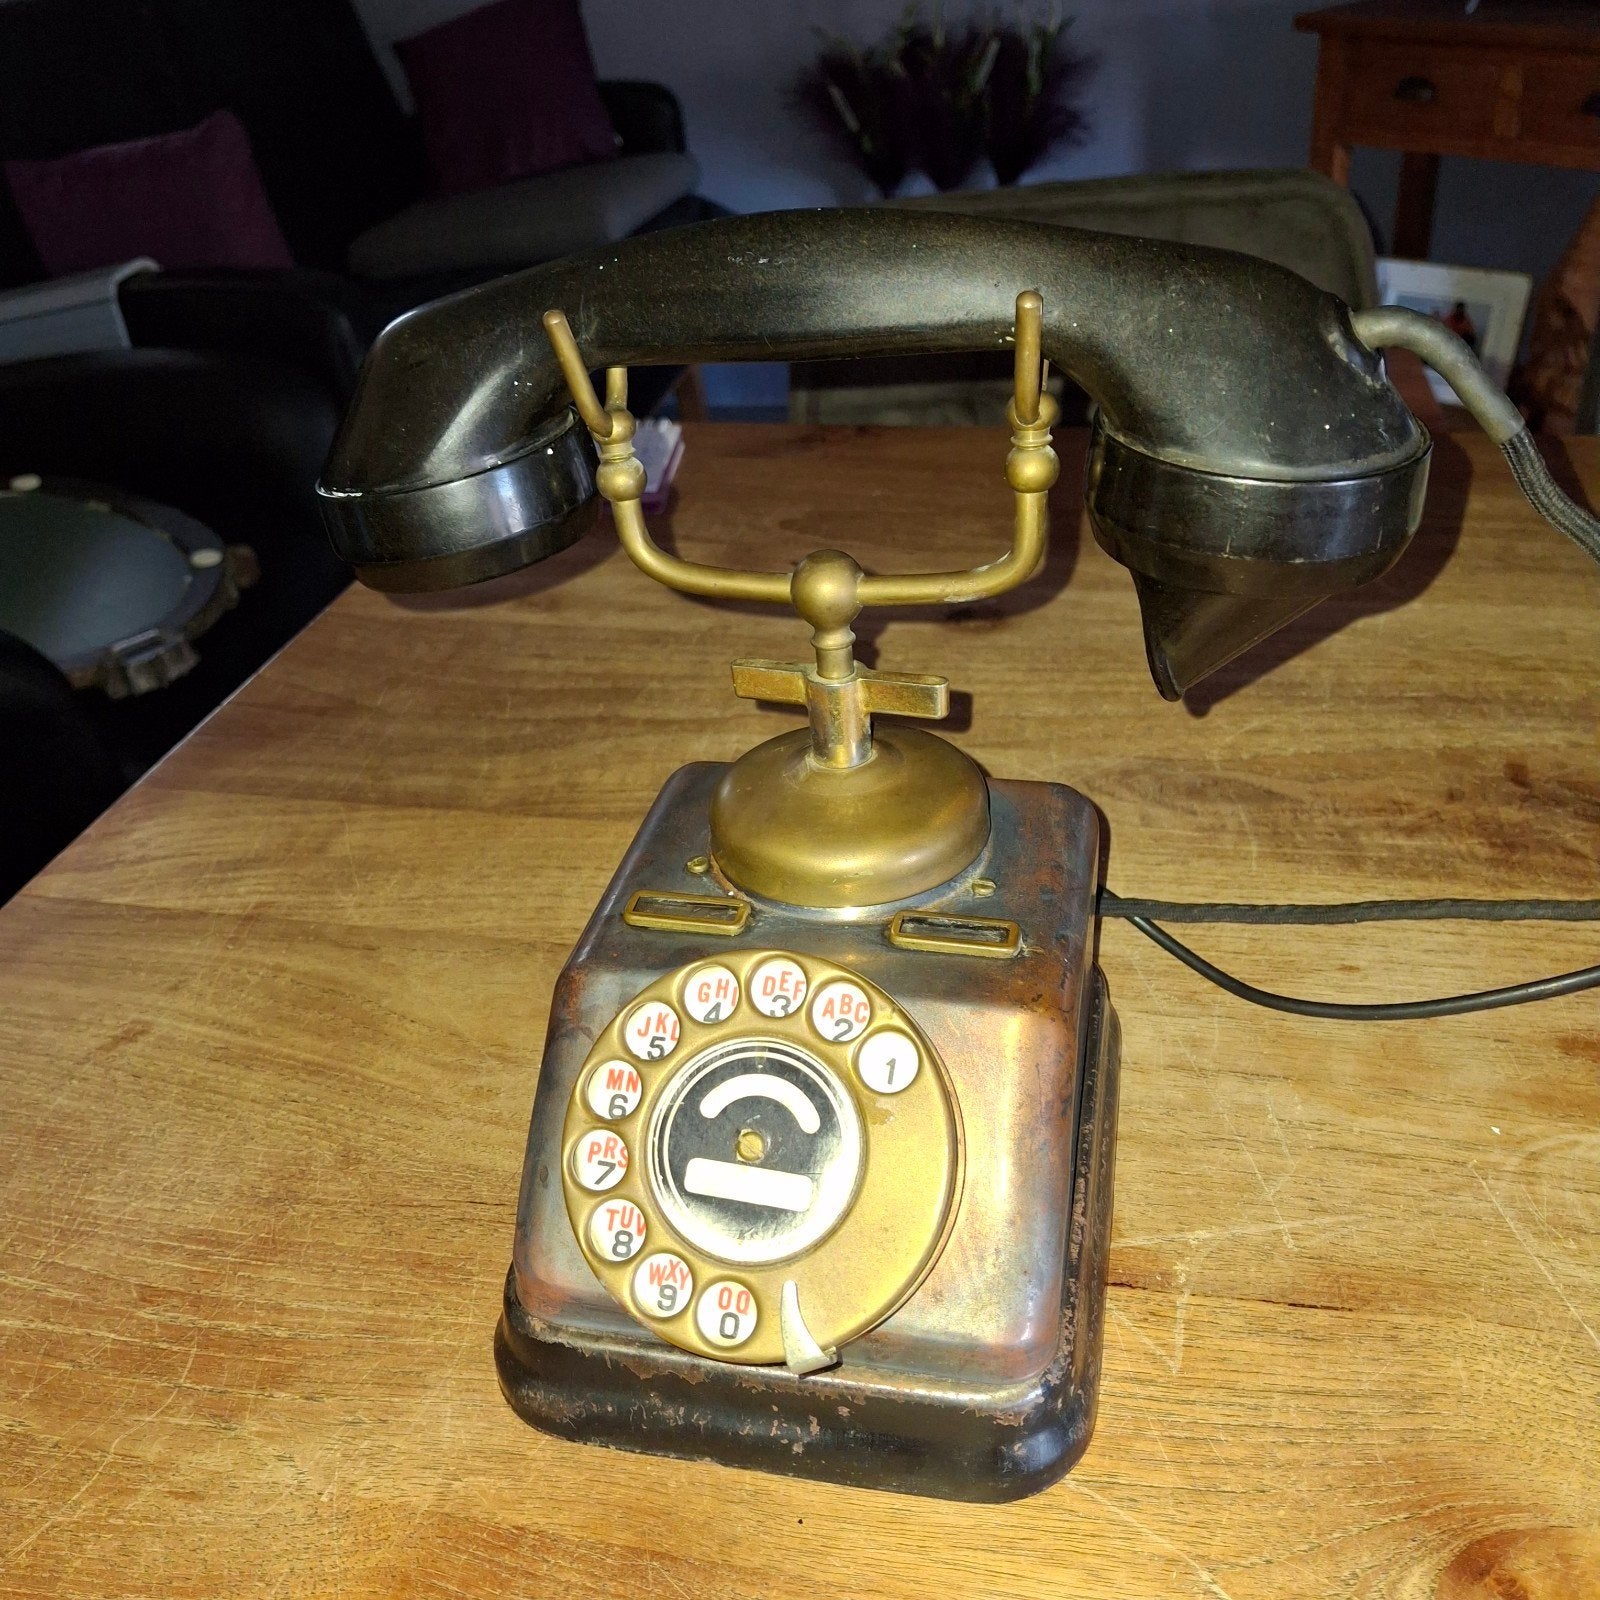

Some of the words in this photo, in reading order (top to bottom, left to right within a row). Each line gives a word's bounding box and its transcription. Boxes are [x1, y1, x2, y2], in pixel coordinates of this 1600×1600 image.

[697, 978, 738, 1007] GHI
[762, 970, 806, 1001] DEF
[703, 1001, 722, 1022] 4
[769, 994, 792, 1018] 3
[822, 993, 869, 1024] ABC
[637, 1012, 680, 1041] JKL
[832, 1017, 854, 1041] 2
[647, 1035, 666, 1060] 5
[606, 1068, 641, 1094] MN
[885, 1057, 897, 1085] 1
[608, 1093, 629, 1119] 6
[587, 1136, 629, 1169] PRS
[593, 1160, 616, 1185] 7
[612, 1230, 634, 1259] 8
[649, 1259, 690, 1290] WXY
[657, 1284, 678, 1311] 9
